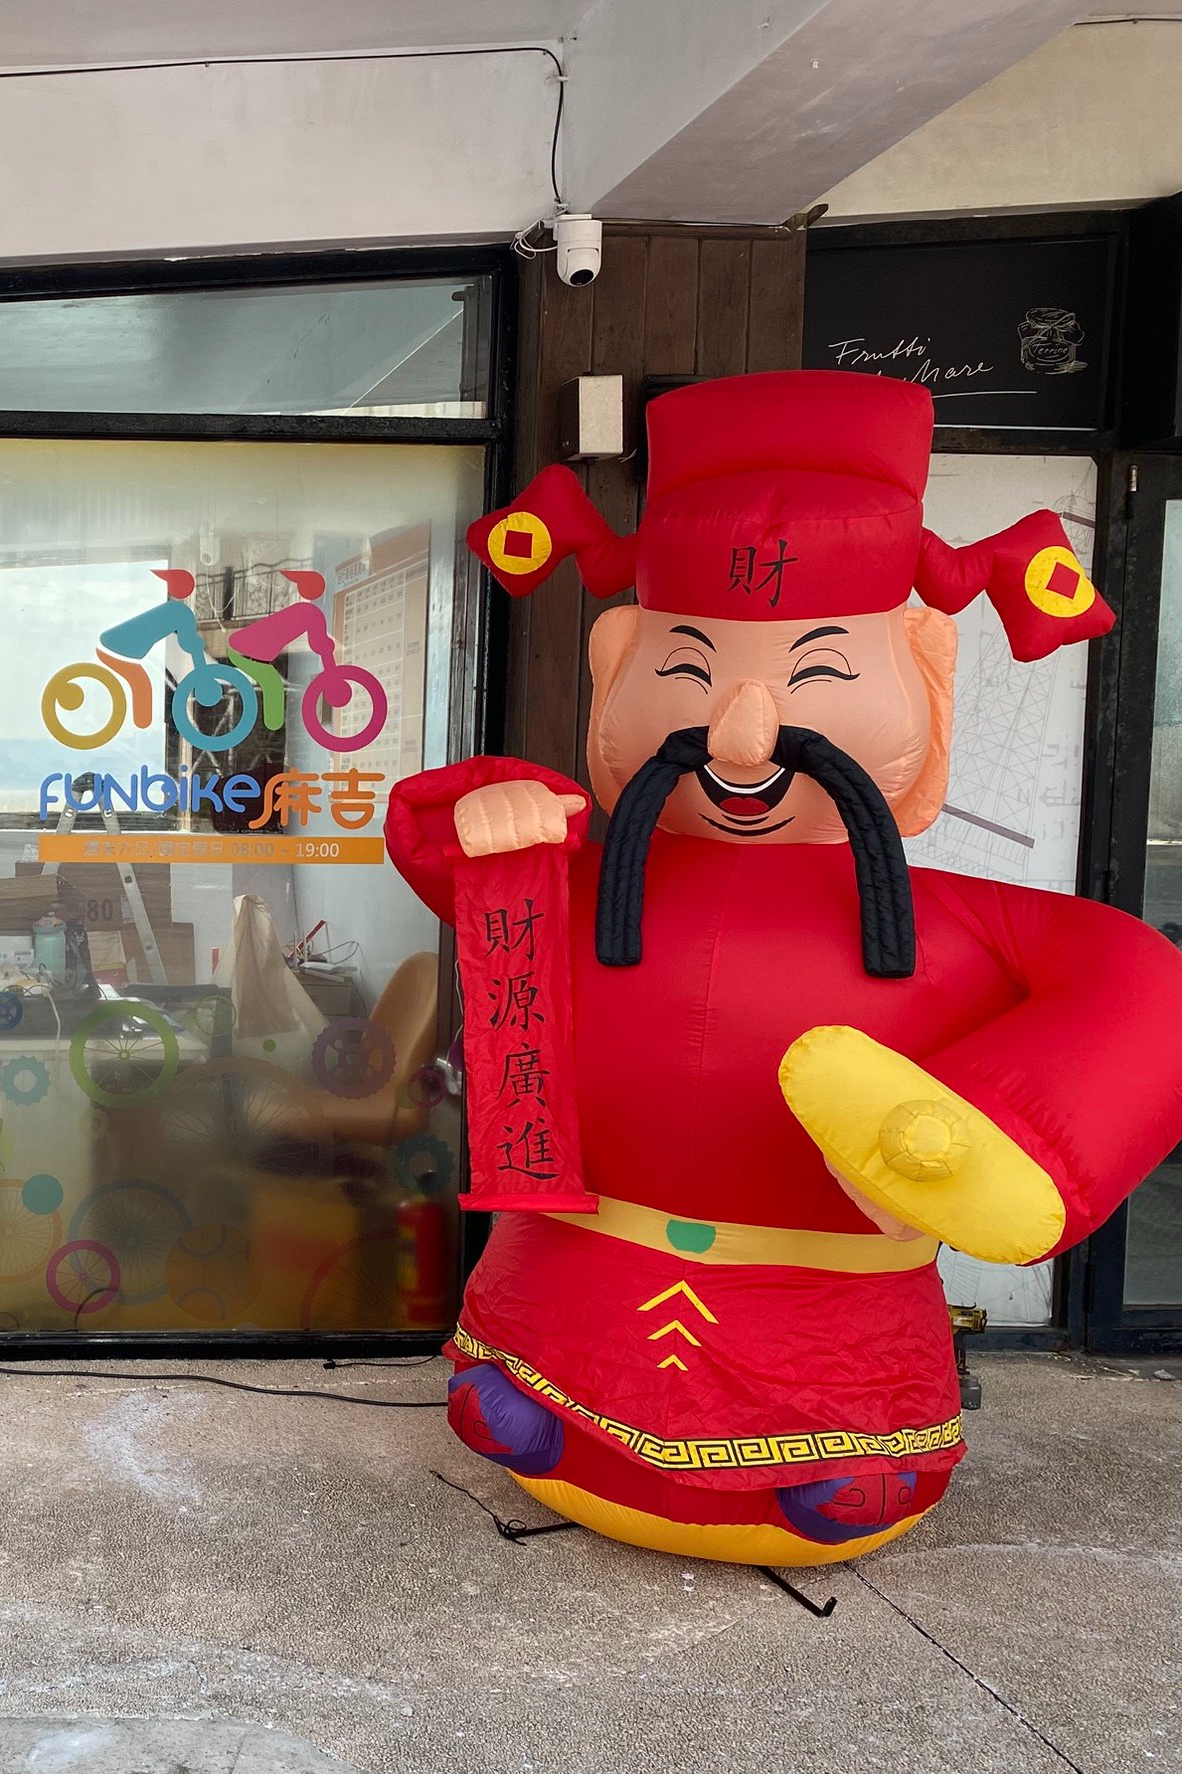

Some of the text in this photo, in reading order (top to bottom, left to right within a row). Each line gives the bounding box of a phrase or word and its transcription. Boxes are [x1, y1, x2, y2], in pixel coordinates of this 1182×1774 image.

[726, 540, 798, 607] 財
[296, 843, 340, 858] 19:00
[484, 899, 560, 1180] 財源廣進
